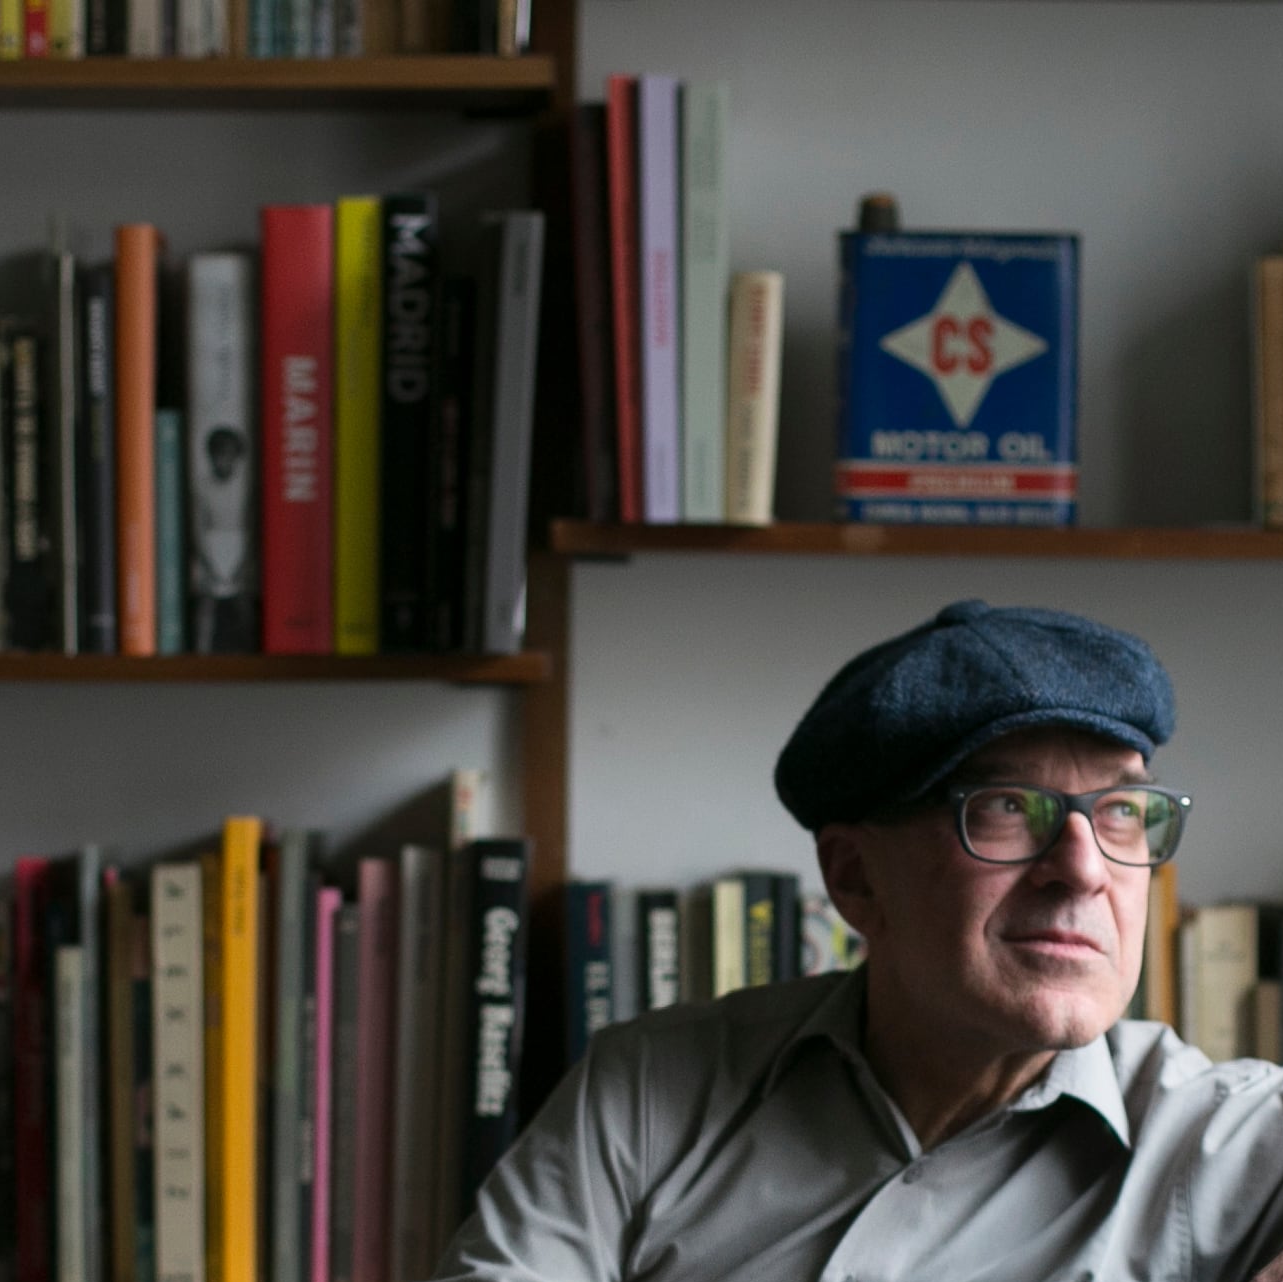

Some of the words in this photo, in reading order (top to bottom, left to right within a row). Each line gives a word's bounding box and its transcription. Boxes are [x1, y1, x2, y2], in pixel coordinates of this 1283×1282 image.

[389, 213, 432, 404] MADRID
[932, 315, 993, 374] CS
[284, 354, 318, 502] MARIN
[870, 430, 990, 458] MOTOR
[998, 432, 1053, 460] OIL
[476, 906, 518, 995] Georg
[475, 1003, 516, 1118] Baselitz
